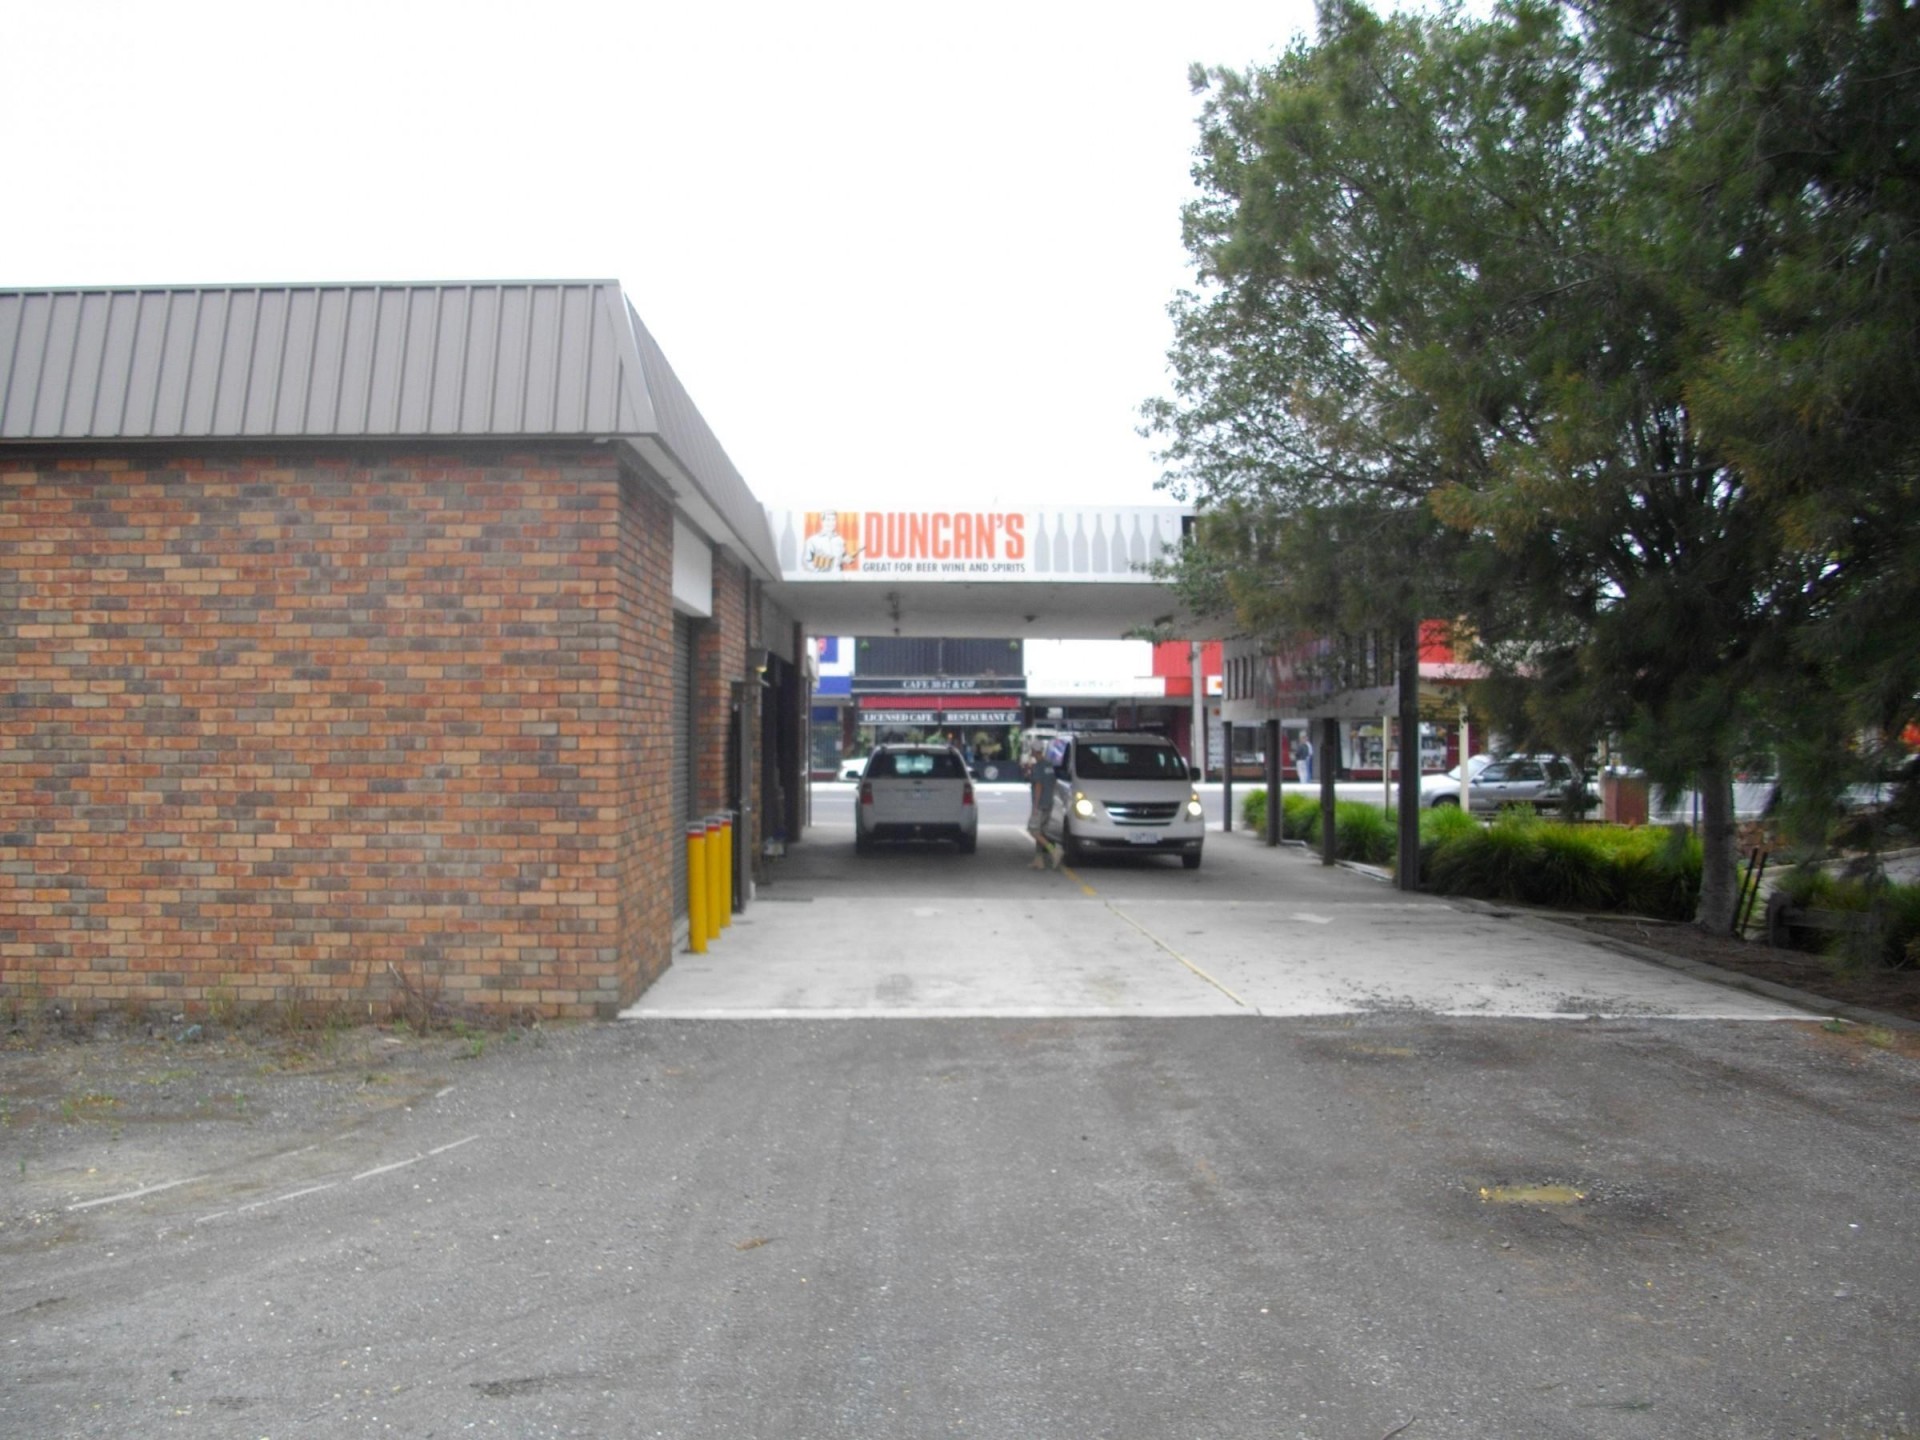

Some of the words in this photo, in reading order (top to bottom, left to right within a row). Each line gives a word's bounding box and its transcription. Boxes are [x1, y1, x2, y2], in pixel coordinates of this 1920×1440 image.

[864, 511, 1026, 560] DUNCAN'S
[862, 562, 892, 573] GREAT
[894, 562, 913, 573] FOR
[916, 562, 938, 573] BEER
[941, 562, 966, 573] WINE
[968, 562, 989, 573] AND
[991, 562, 1026, 573] SPIRITS
[902, 680, 928, 689] CAFE
[863, 713, 910, 723] LICENSED
[910, 713, 933, 723] CAFE
[946, 713, 1005, 722] RESTAURANT
